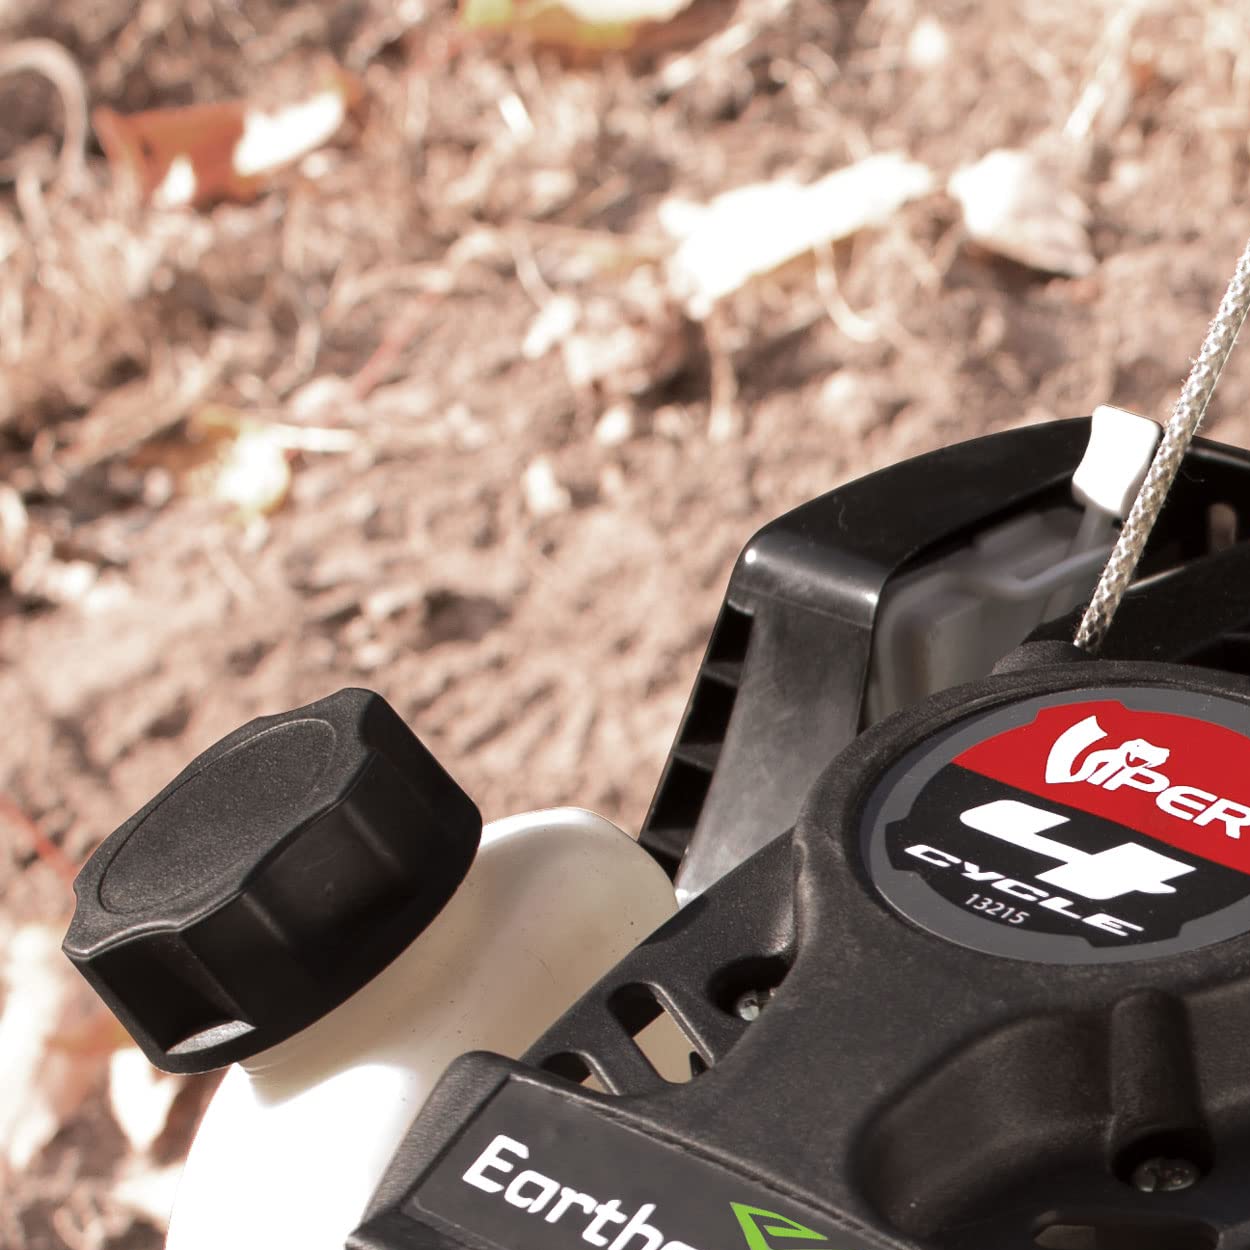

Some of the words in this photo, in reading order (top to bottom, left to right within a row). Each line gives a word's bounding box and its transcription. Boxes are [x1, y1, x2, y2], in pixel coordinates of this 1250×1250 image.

[904, 844, 1145, 938] CYCLE
[959, 799, 1197, 901] 4
[965, 892, 1030, 925] 13215
